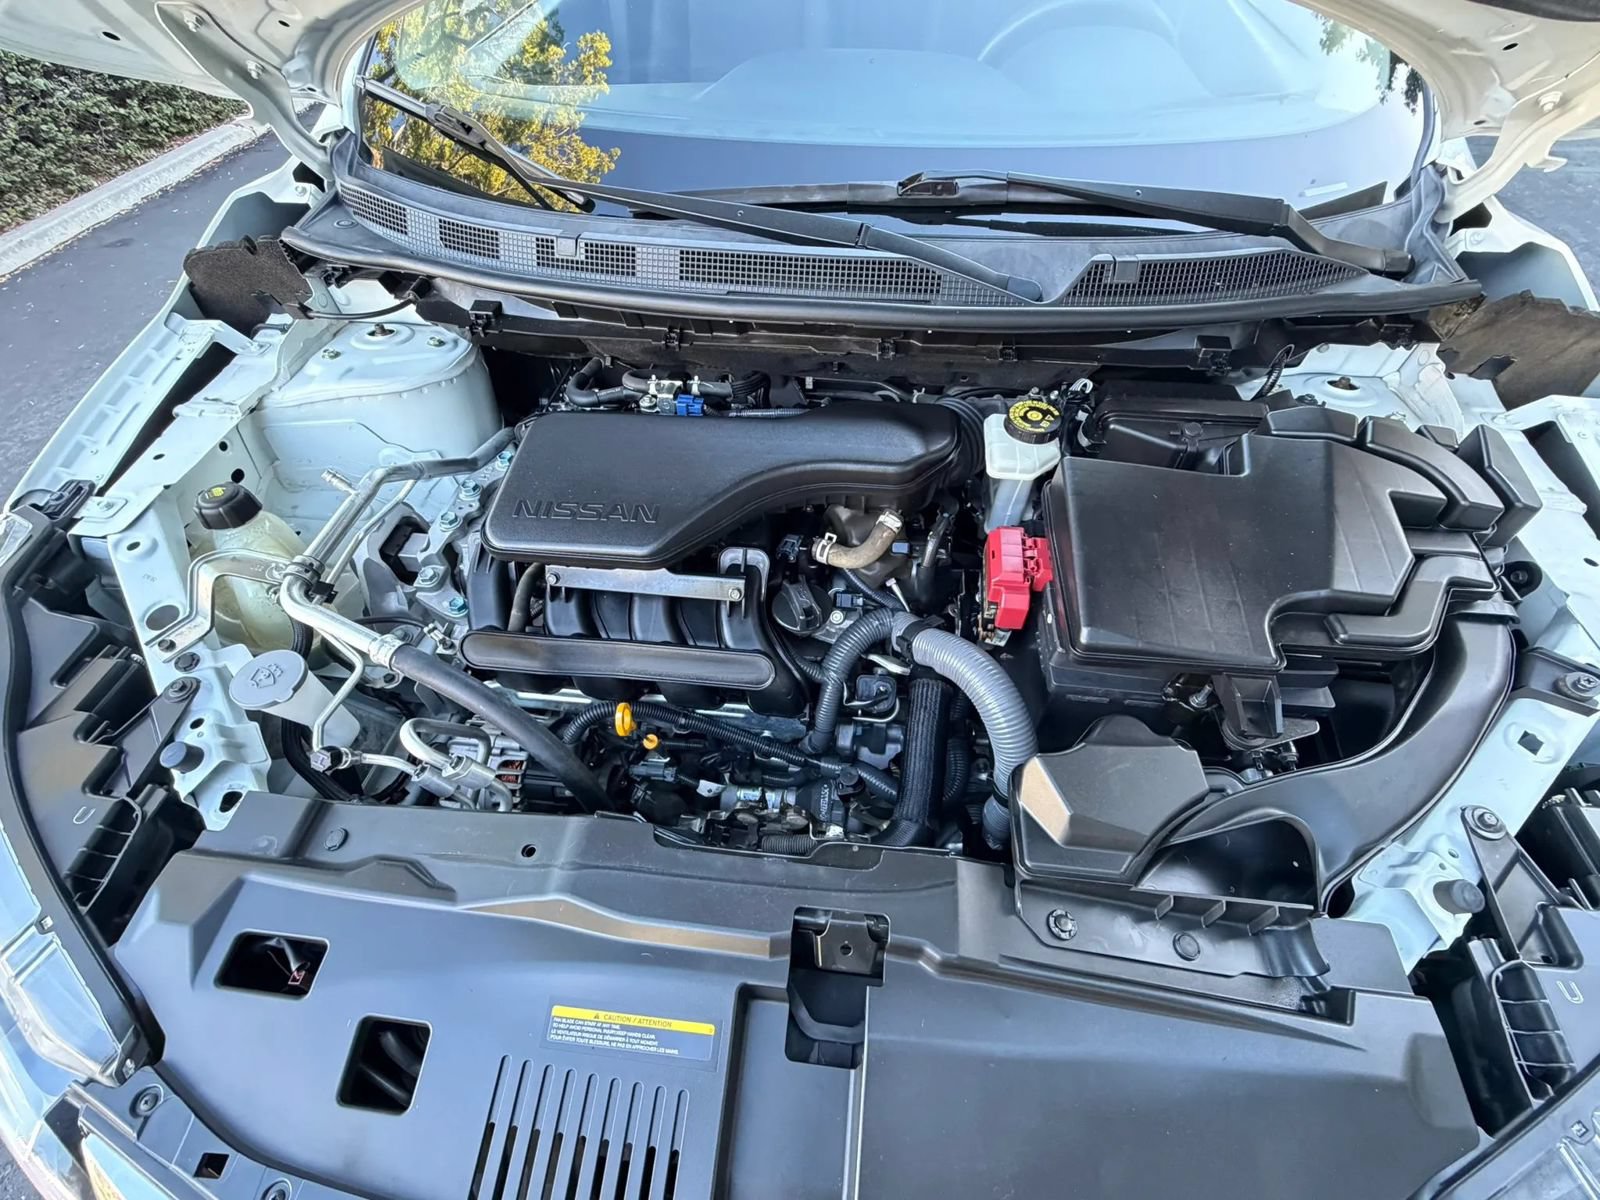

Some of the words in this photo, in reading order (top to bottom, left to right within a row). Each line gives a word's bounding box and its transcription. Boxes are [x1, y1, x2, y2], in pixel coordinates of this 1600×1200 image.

[511, 500, 660, 523] NISSAN
[604, 1014, 632, 1023] CAUTION
[637, 1018, 672, 1028] ATTENTION
